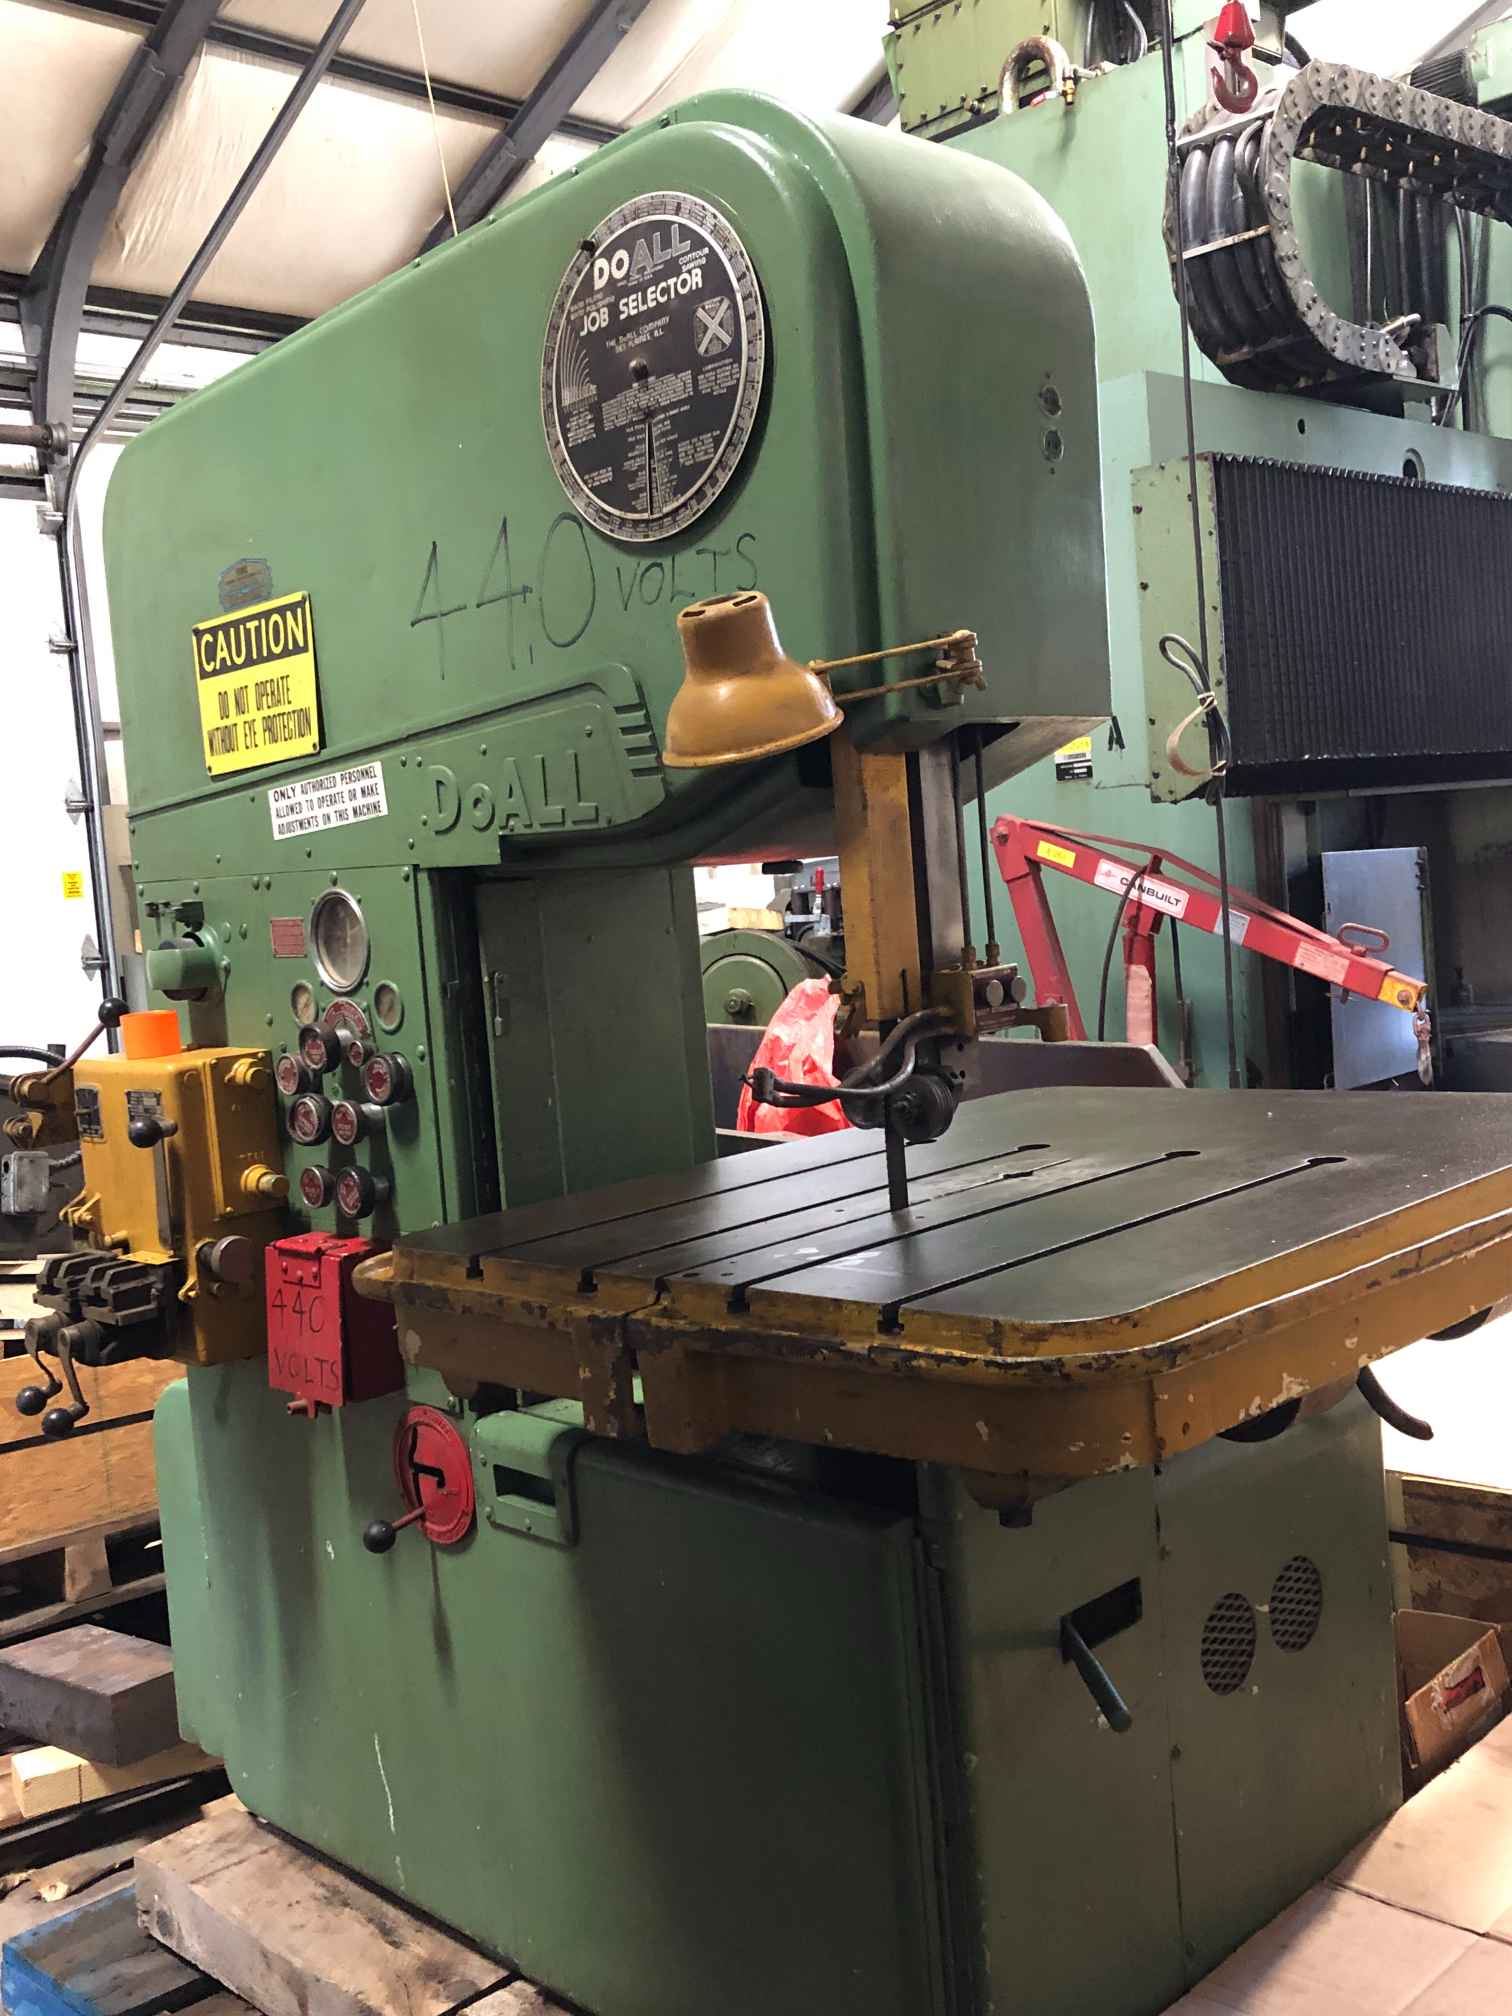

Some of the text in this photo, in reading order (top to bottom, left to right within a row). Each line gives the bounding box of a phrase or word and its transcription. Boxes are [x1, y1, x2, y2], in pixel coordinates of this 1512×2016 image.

[679, 247, 709, 265] CONTOUR
[579, 306, 609, 337] JOB
[618, 267, 703, 321] SELECTOR
[410, 511, 757, 681] 440 VOLTS
[200, 607, 305, 673] CAUTION
[217, 674, 292, 720] DO NOT OPERATE
[207, 705, 312, 757] WITHOUT EYE PROTECTION
[273, 764, 377, 803] ONLY AUTHORIZED PERSONNEL
[275, 782, 380, 819] ALLOWED TO OPERATE OR MAKE
[277, 799, 382, 836] ADJUSTMENTS ON THIS MACHINE
[272, 1347, 342, 1391] VOLTS
